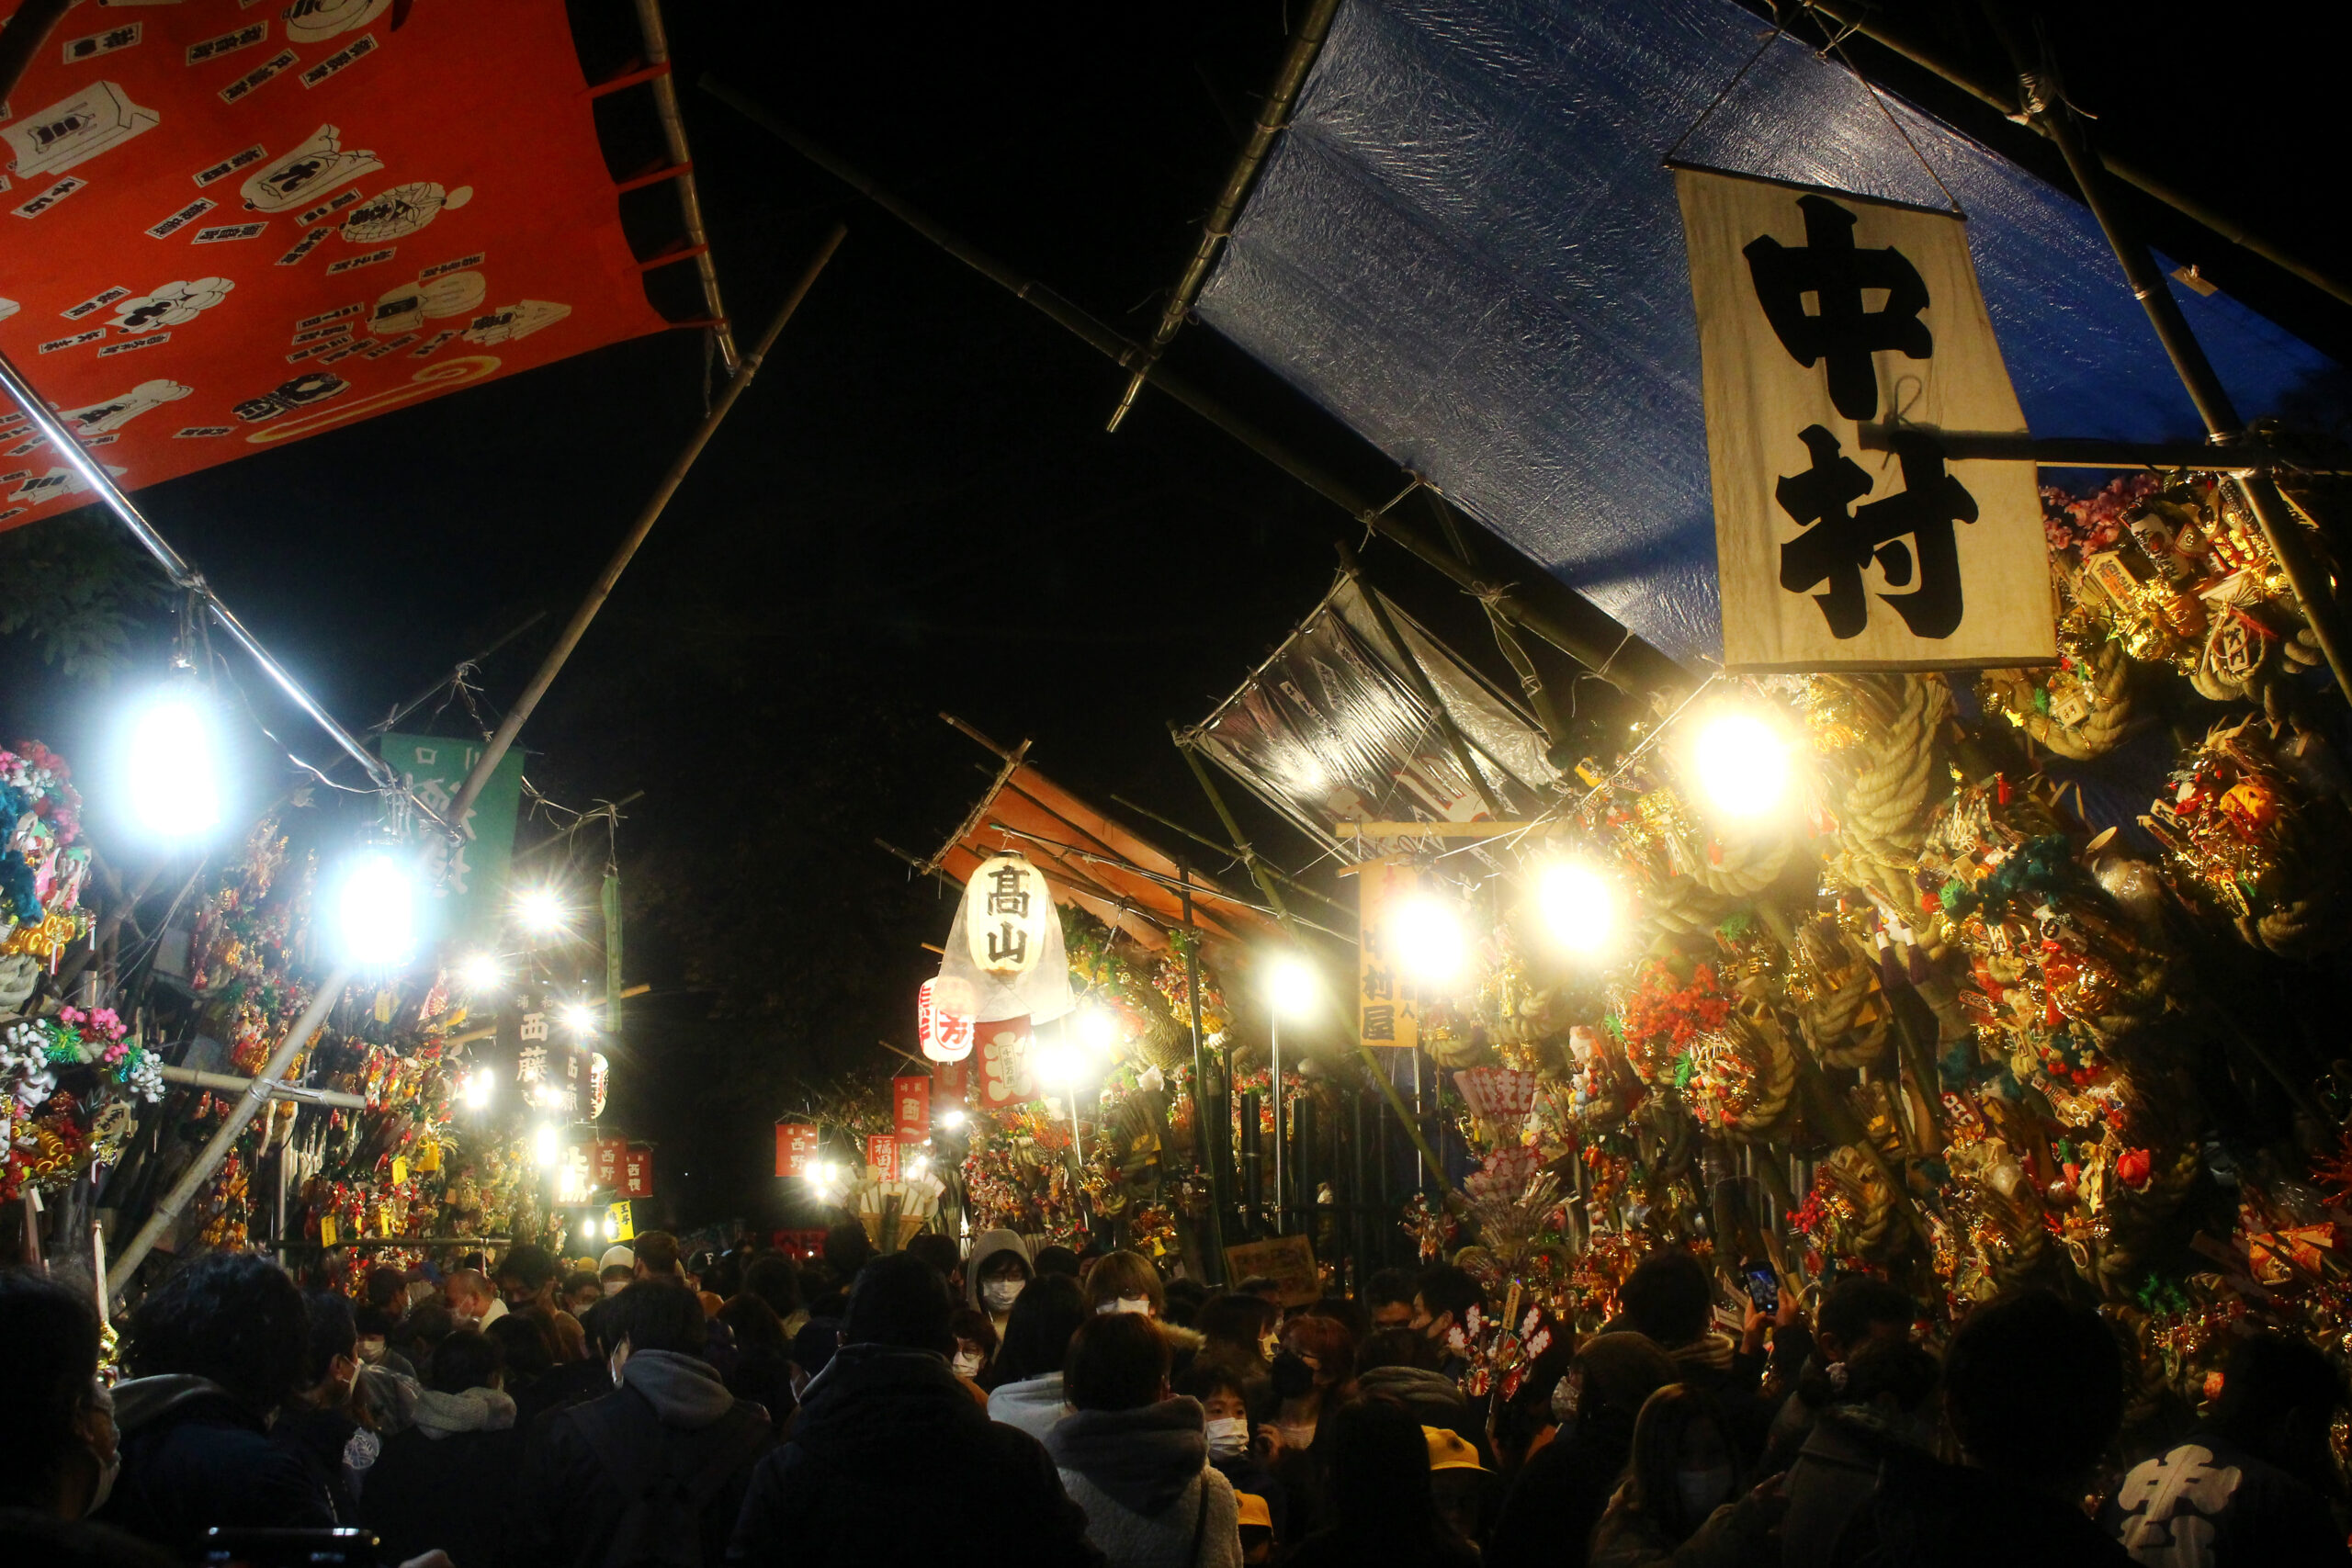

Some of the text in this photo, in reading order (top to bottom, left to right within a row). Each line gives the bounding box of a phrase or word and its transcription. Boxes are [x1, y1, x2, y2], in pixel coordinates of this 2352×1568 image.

[1743, 194, 1979, 639] 中村
[791, 1137, 807, 1170] 西野
[875, 1139, 892, 1184] 福田屋
[705, 1252, 714, 1266] F
